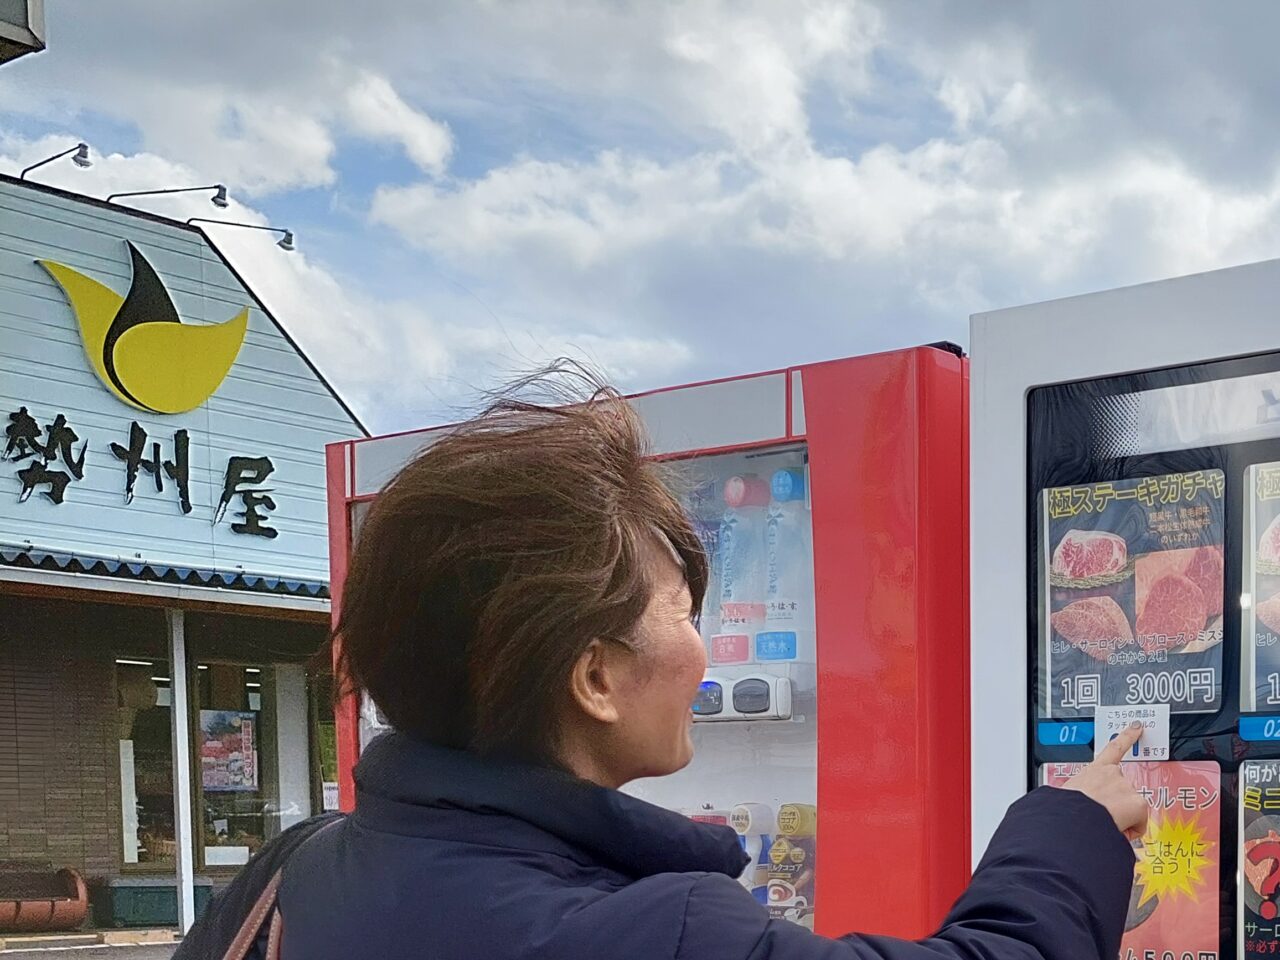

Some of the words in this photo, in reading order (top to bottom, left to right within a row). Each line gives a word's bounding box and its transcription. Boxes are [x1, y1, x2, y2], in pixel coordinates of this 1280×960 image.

[1050, 471, 1225, 519] 極ステーキガチャ
[1061, 674, 1100, 709] 1回
[1126, 667, 1216, 705] 3000円
[1107, 709, 1156, 719] こちらの商品は
[1059, 725, 1077, 742] 01
[1107, 720, 1156, 730] タッチルの
[1144, 840, 1205, 857] ごはんに
